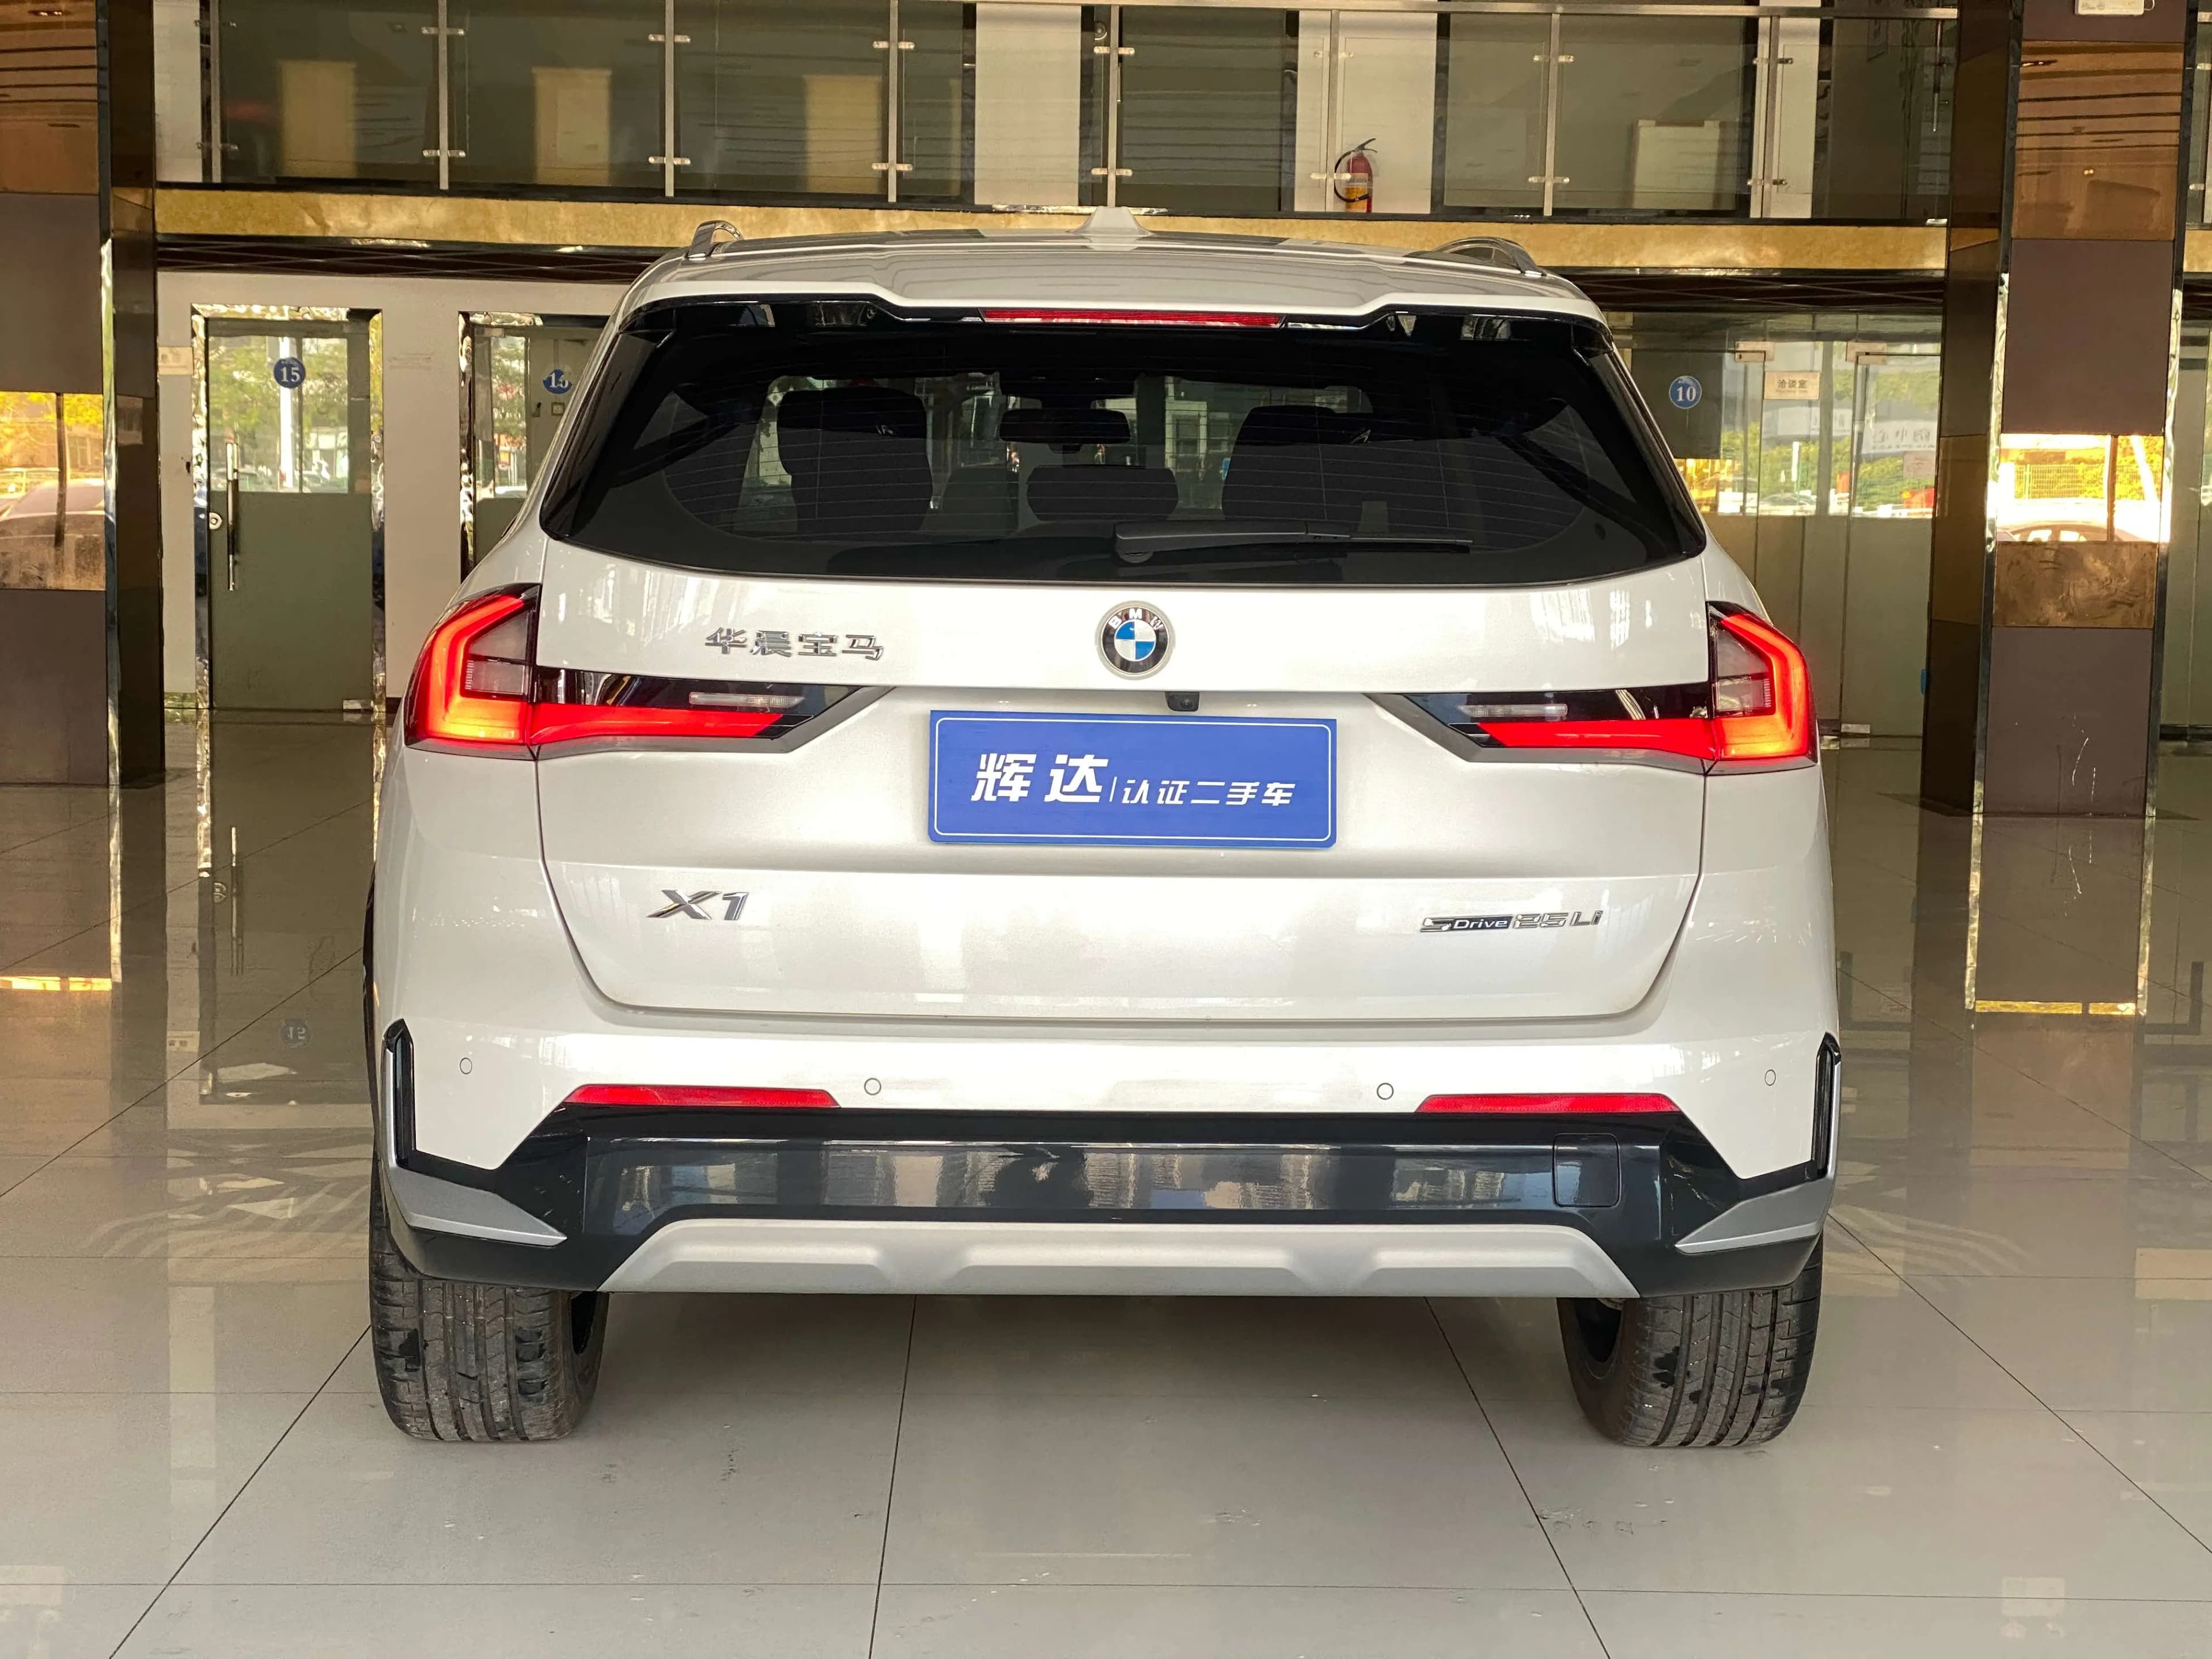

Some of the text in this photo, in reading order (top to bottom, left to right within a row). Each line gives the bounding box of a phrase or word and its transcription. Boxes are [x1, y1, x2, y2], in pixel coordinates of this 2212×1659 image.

[281, 366, 301, 382] 15
[1778, 378, 1808, 389] 洽谈室
[1677, 386, 1696, 402] 10
[1108, 608, 1164, 631] BMW
[704, 627, 885, 661] 华晨宝马
[971, 753, 1296, 806] 辉达 认证二手车
[646, 889, 749, 921] X1
